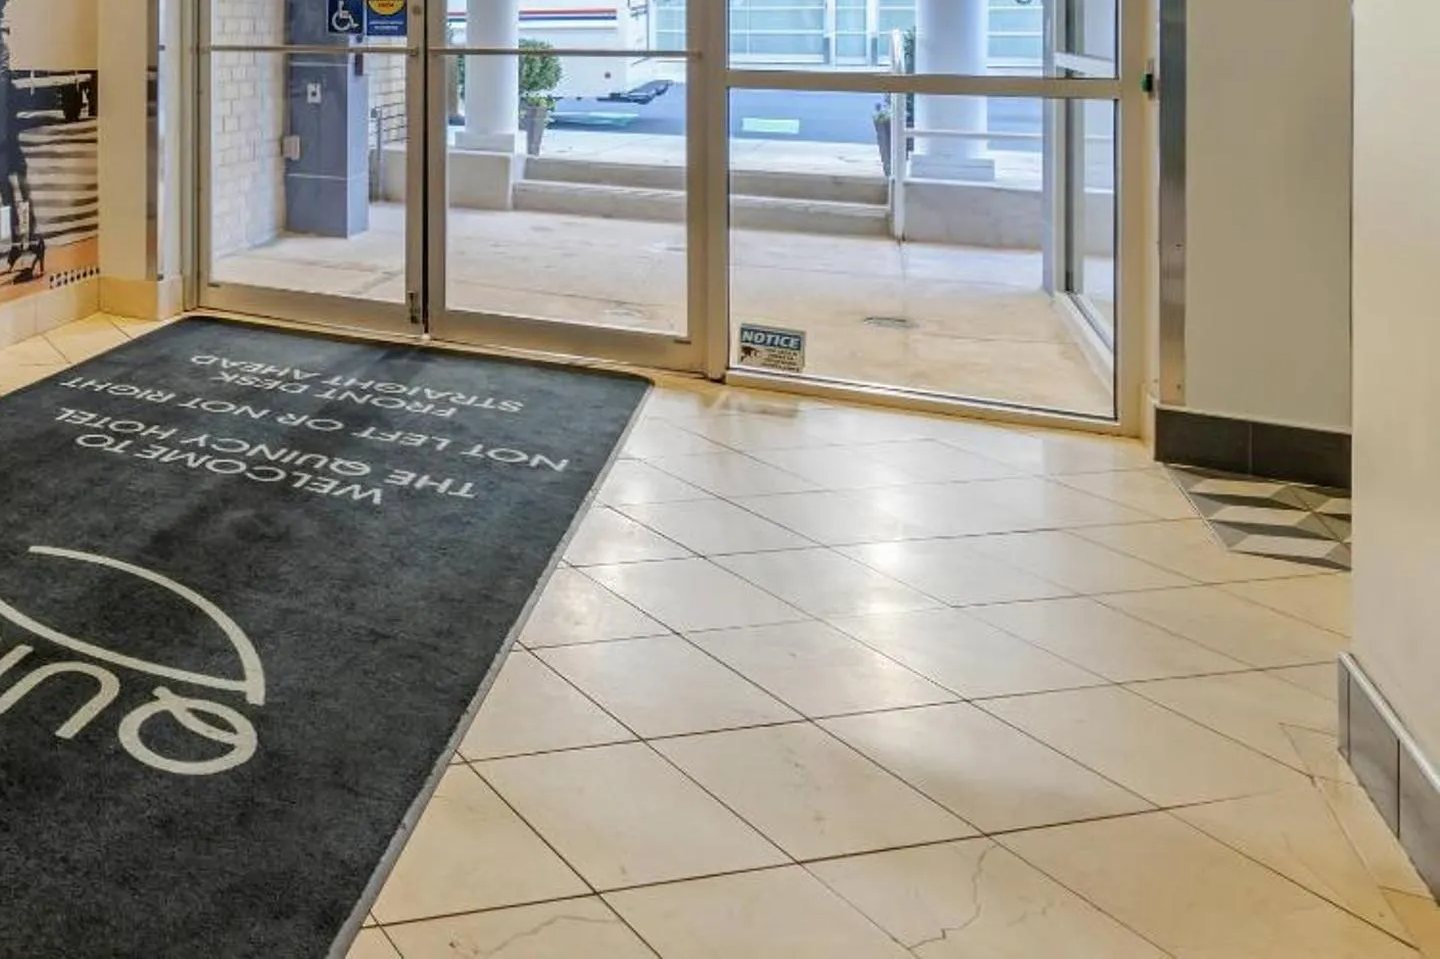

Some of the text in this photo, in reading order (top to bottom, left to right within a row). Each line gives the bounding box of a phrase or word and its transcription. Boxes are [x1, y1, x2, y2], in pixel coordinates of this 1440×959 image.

[742, 330, 801, 350] NOTICE
[190, 353, 525, 413] STRAIGHT AHEAD
[209, 370, 458, 419] FRONT DESK
[55, 406, 478, 499] THE QUINCY HOTEL
[59, 376, 570, 473] NOT LEFT OR NOT RIGHT
[74, 433, 383, 506] WELCOME TO
